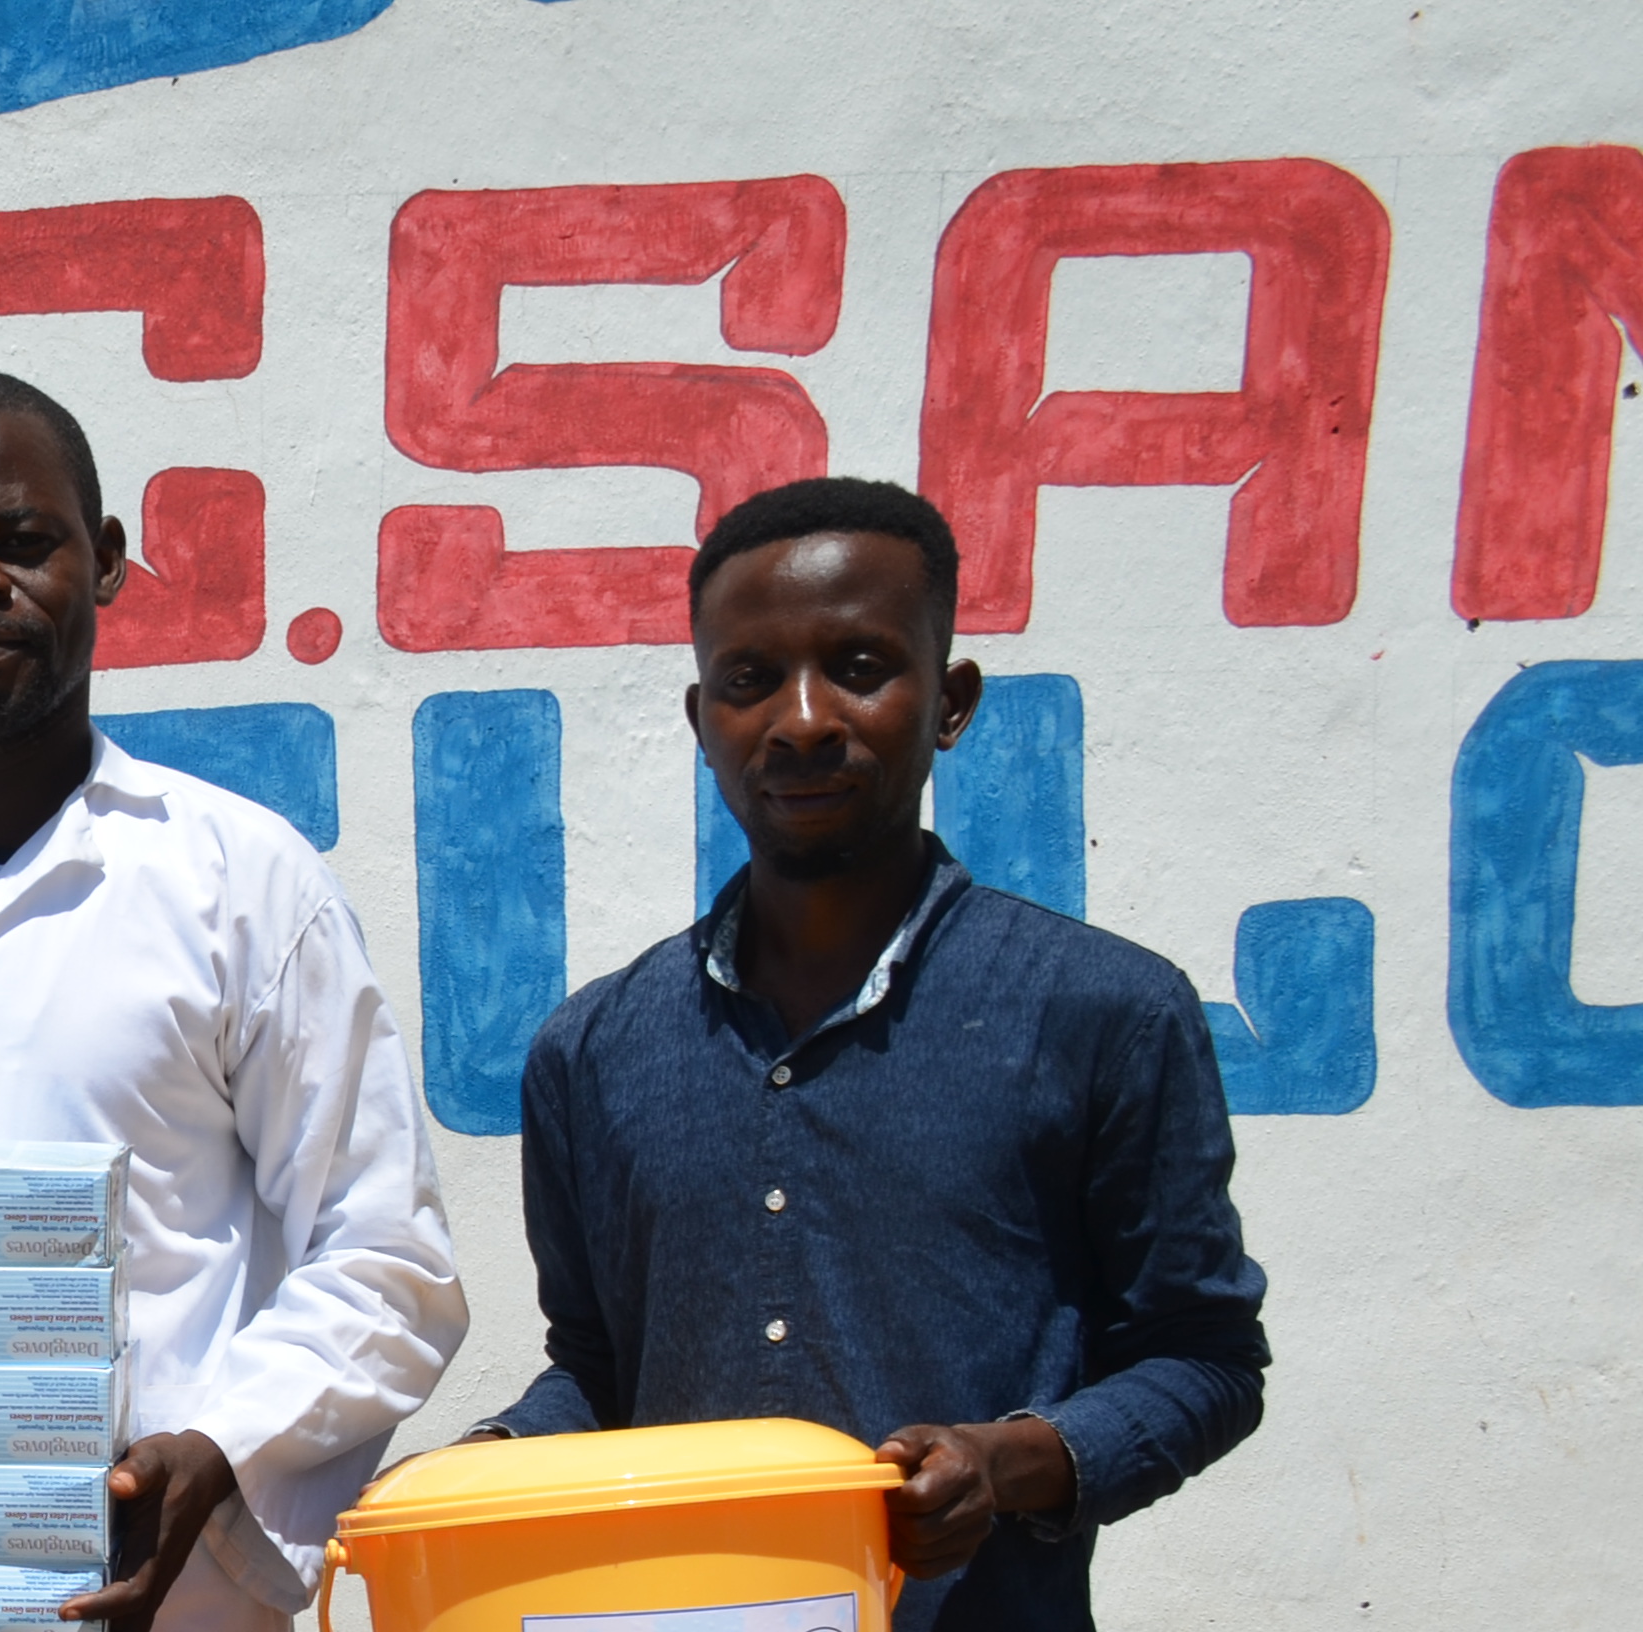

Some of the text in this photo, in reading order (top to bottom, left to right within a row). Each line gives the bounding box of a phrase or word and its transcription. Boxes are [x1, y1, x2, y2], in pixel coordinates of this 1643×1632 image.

[5, 1238, 92, 1257] Davigloves
[12, 1338, 99, 1357] Davigloves
[13, 1437, 99, 1456] Davigloves
[7, 1535, 93, 1555] Davigloves
